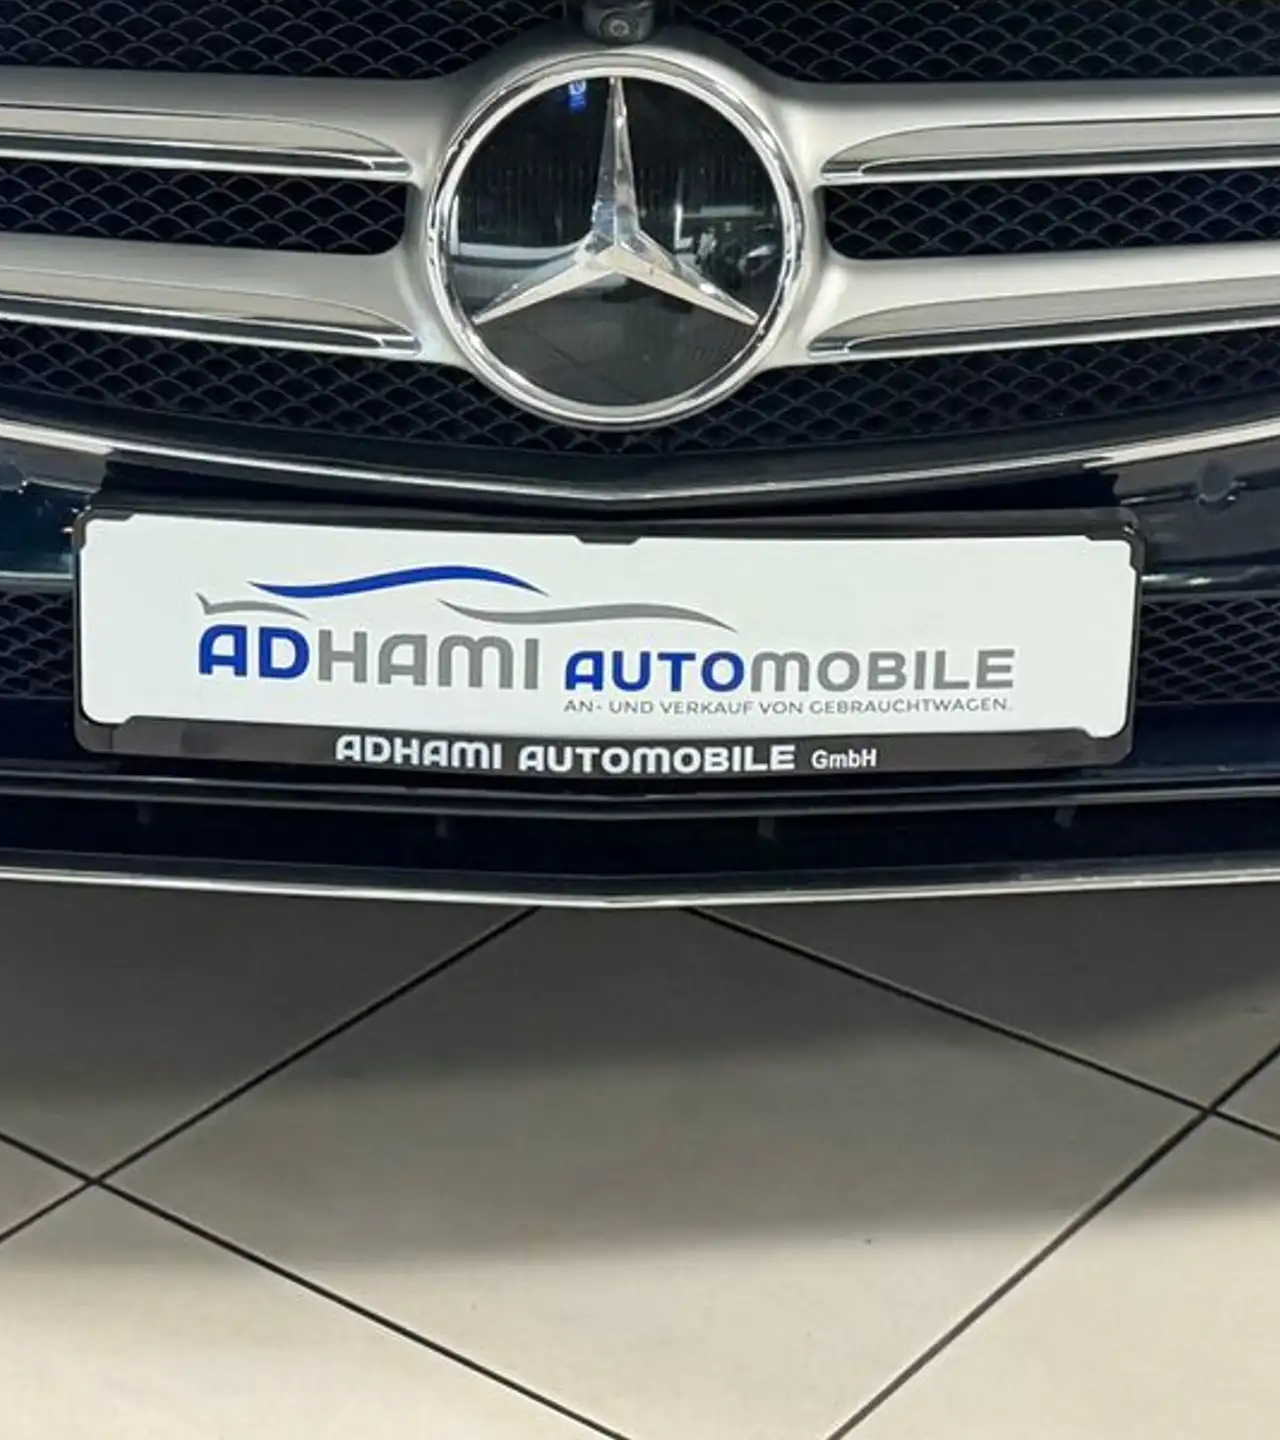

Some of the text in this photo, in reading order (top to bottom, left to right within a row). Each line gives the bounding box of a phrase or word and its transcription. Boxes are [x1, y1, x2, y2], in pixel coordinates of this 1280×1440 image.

[198, 624, 1015, 693] ADHAMI AUTOMOBILE
[563, 700, 602, 713] AN-
[609, 700, 654, 714] UND
[660, 700, 754, 715] VERKAUF
[760, 700, 803, 715] VON
[335, 734, 877, 774] ADHAMI AUTOMOBILE GmbH
